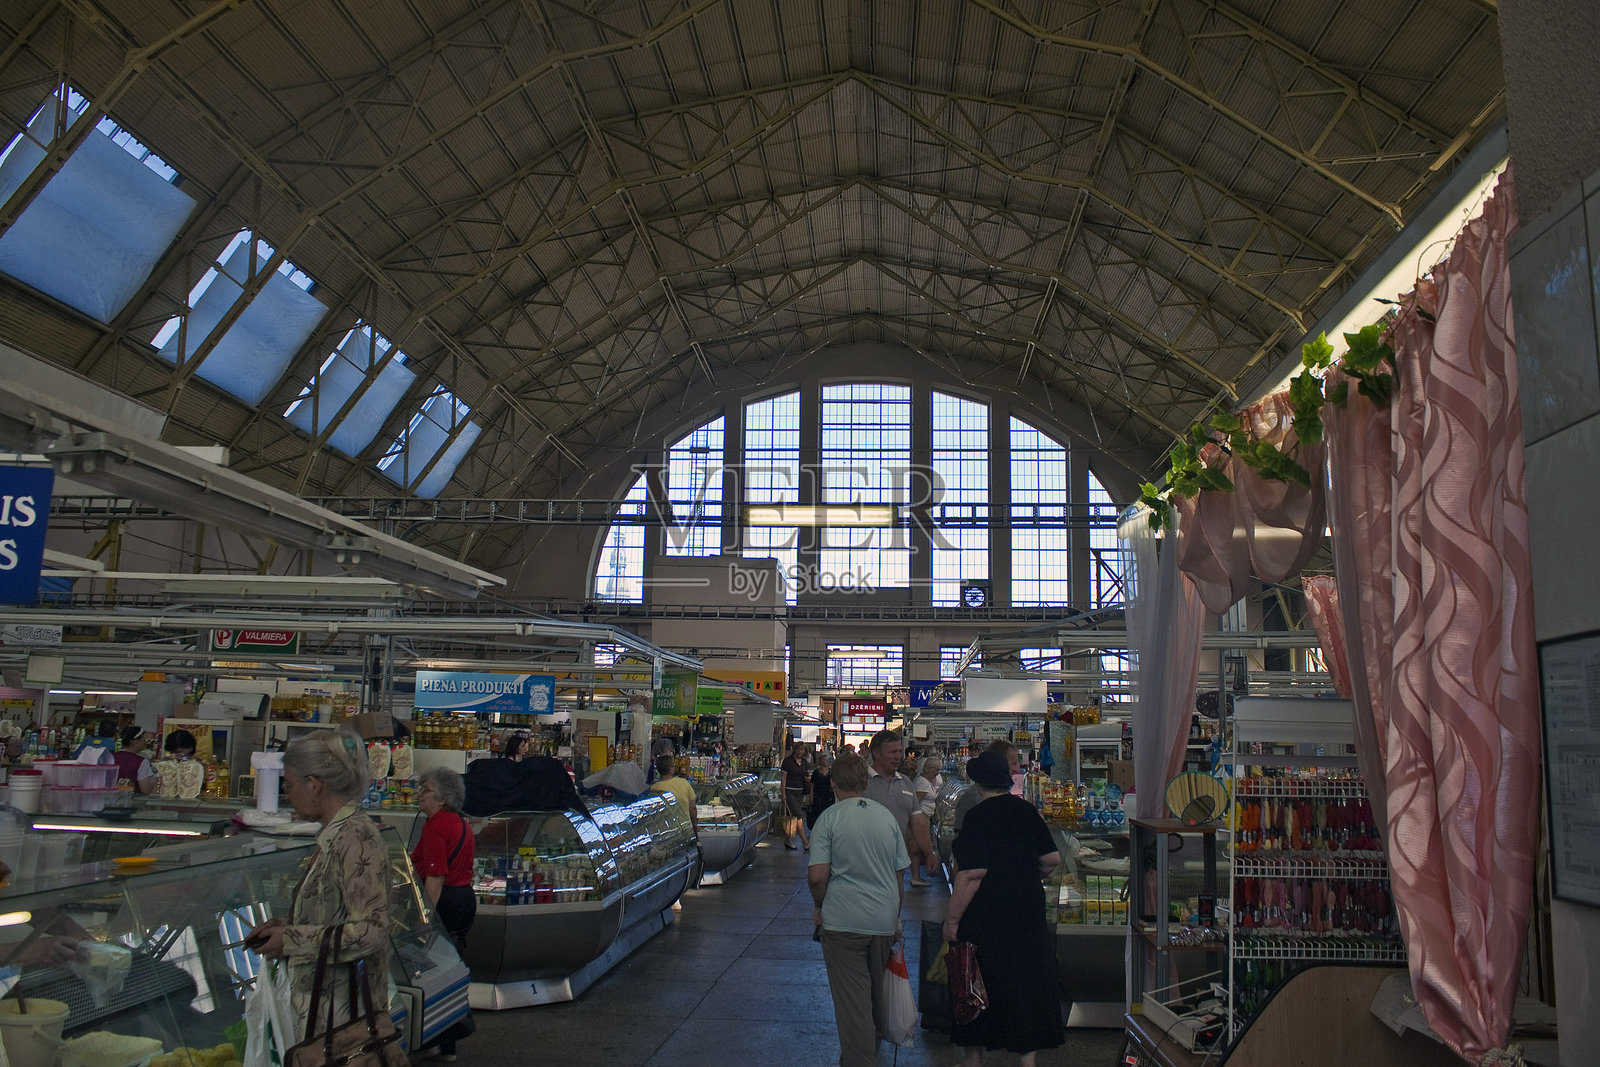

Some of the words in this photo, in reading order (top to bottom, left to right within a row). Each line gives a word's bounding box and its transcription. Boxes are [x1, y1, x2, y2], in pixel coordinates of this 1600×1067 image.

[245, 631, 287, 641] VALMIERA
[421, 679, 458, 693] PIENA
[461, 680, 524, 695] PRODUKTI
[656, 687, 677, 698] KAZAS
[656, 698, 675, 709] PIENS
[530, 983, 537, 994] 1
